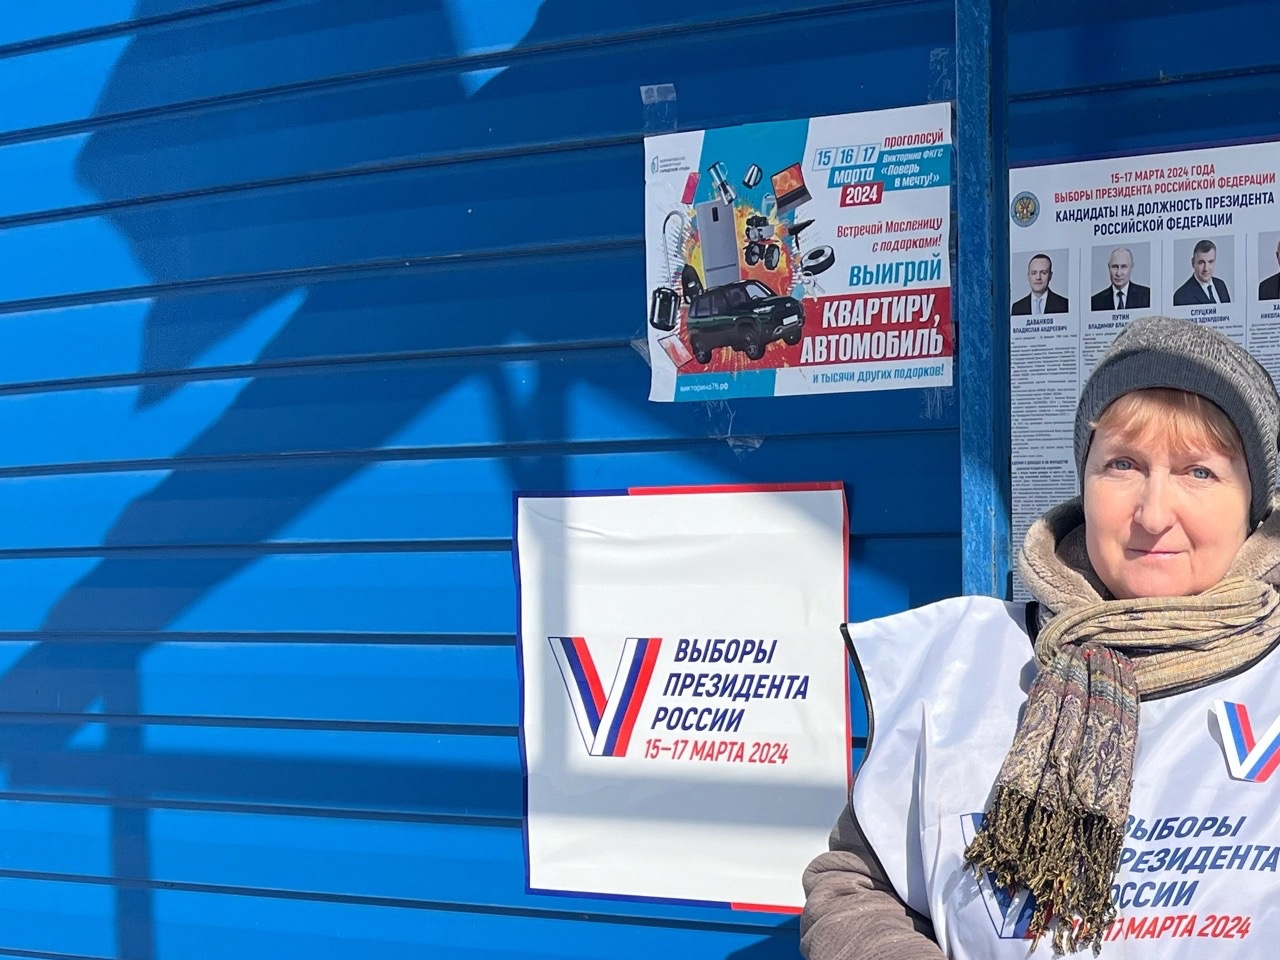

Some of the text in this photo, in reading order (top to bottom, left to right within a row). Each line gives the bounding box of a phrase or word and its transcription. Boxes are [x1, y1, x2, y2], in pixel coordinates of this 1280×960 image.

[884, 128, 944, 149] проголосуй
[817, 146, 876, 166] 15 16 17
[882, 148, 943, 164] Викторина ФКГС
[881, 163, 920, 176] «Поверь
[902, 172, 940, 187] мечту!»
[1135, 168, 1165, 182] МАРТА
[1167, 166, 1189, 179] 2024
[1191, 164, 1216, 176] ГОДА
[845, 185, 878, 204] 2024
[1054, 172, 1276, 203] ВЫБОРЫ ПРЕЗИДЕНТА РОССИЙСКОЙ ФЕДЕРАЦИИ
[1055, 191, 1275, 222] КАНДИДАТЫ НА ДОЛЖНОСТЬ ПРЕЗИДЕНТА
[837, 217, 943, 238] Встречай Масленицу
[1094, 213, 1233, 236] РОССИЙСКОЙ ФЕДЕРАЦИИ
[880, 234, 942, 252] подарками!
[822, 294, 941, 329] КВАРТИРУ,
[1026, 318, 1054, 326] ДАВАНКОВ
[1190, 308, 1217, 316] СЛУЦКИЙ
[1012, 326, 1040, 334] ВЛАДИСЛАВ
[1088, 322, 1114, 330] ВЛАДИМИР
[800, 328, 944, 364] АВТОМОБИЛЬ
[821, 371, 855, 384] тысячи
[857, 370, 892, 384] других
[894, 363, 944, 380] подарков!
[673, 638, 778, 664] ВЫБОРЫ
[662, 673, 809, 702] ПРЕЗИДЕНТА
[650, 706, 745, 732] РОССИИ
[689, 740, 745, 762] МАРТА
[748, 742, 789, 764] 2024
[1116, 844, 1280, 874] РЕЗИДЕНТА
[1111, 880, 1200, 909] ССИИ
[1124, 914, 1198, 941] МАРТА
[1197, 914, 1252, 940] 2024
